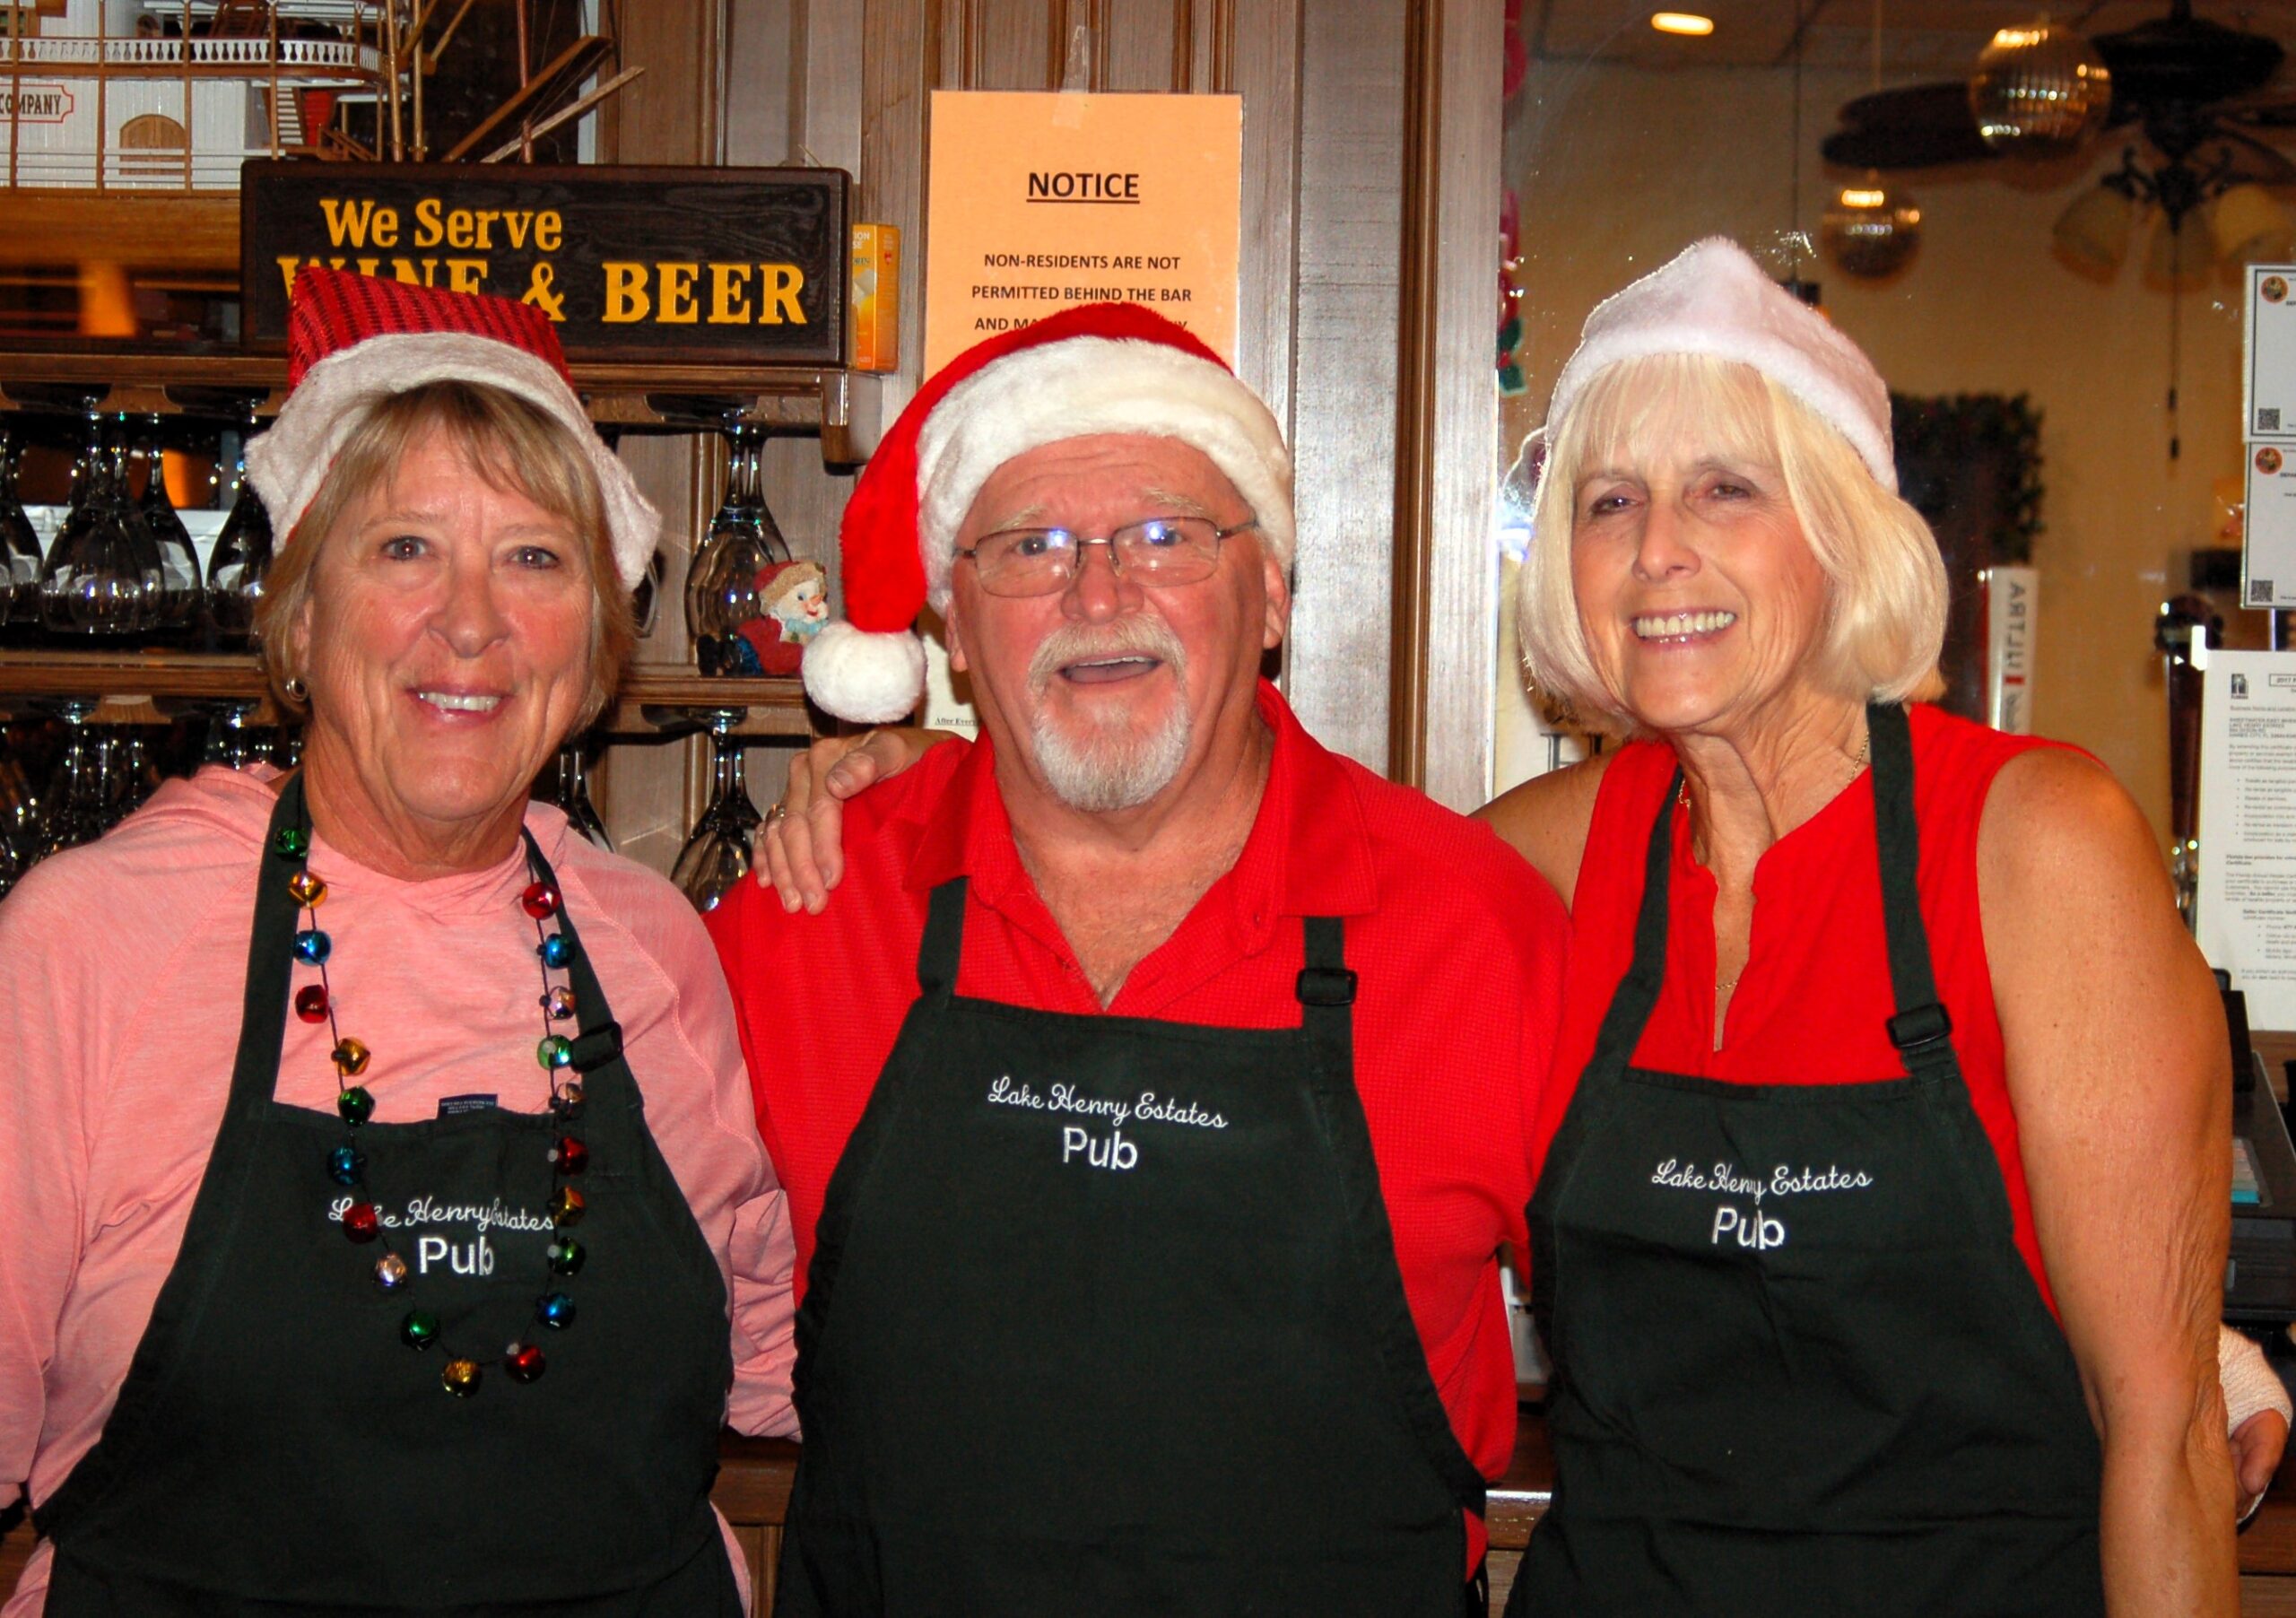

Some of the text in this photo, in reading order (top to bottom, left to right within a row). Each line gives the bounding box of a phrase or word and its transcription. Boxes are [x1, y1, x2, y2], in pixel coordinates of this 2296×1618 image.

[1028, 172, 1140, 198] NOTICE
[319, 198, 562, 251] We Serve
[984, 254, 1180, 271] NON-RESIDENTS ARE NOT
[602, 262, 807, 324] BEER
[972, 285, 1192, 302] PERMITTED BEHIND THE BAR
[974, 317, 1008, 331] AND
[987, 1075, 1229, 1128] Lake Henry Estates
[1063, 1127, 1138, 1170] Pub
[1652, 1159, 1708, 1189] Lake
[1770, 1165, 1873, 1196] Estates
[404, 1196, 492, 1232] Henry
[1711, 1207, 1785, 1249] Pub
[419, 1236, 494, 1275] Pub
